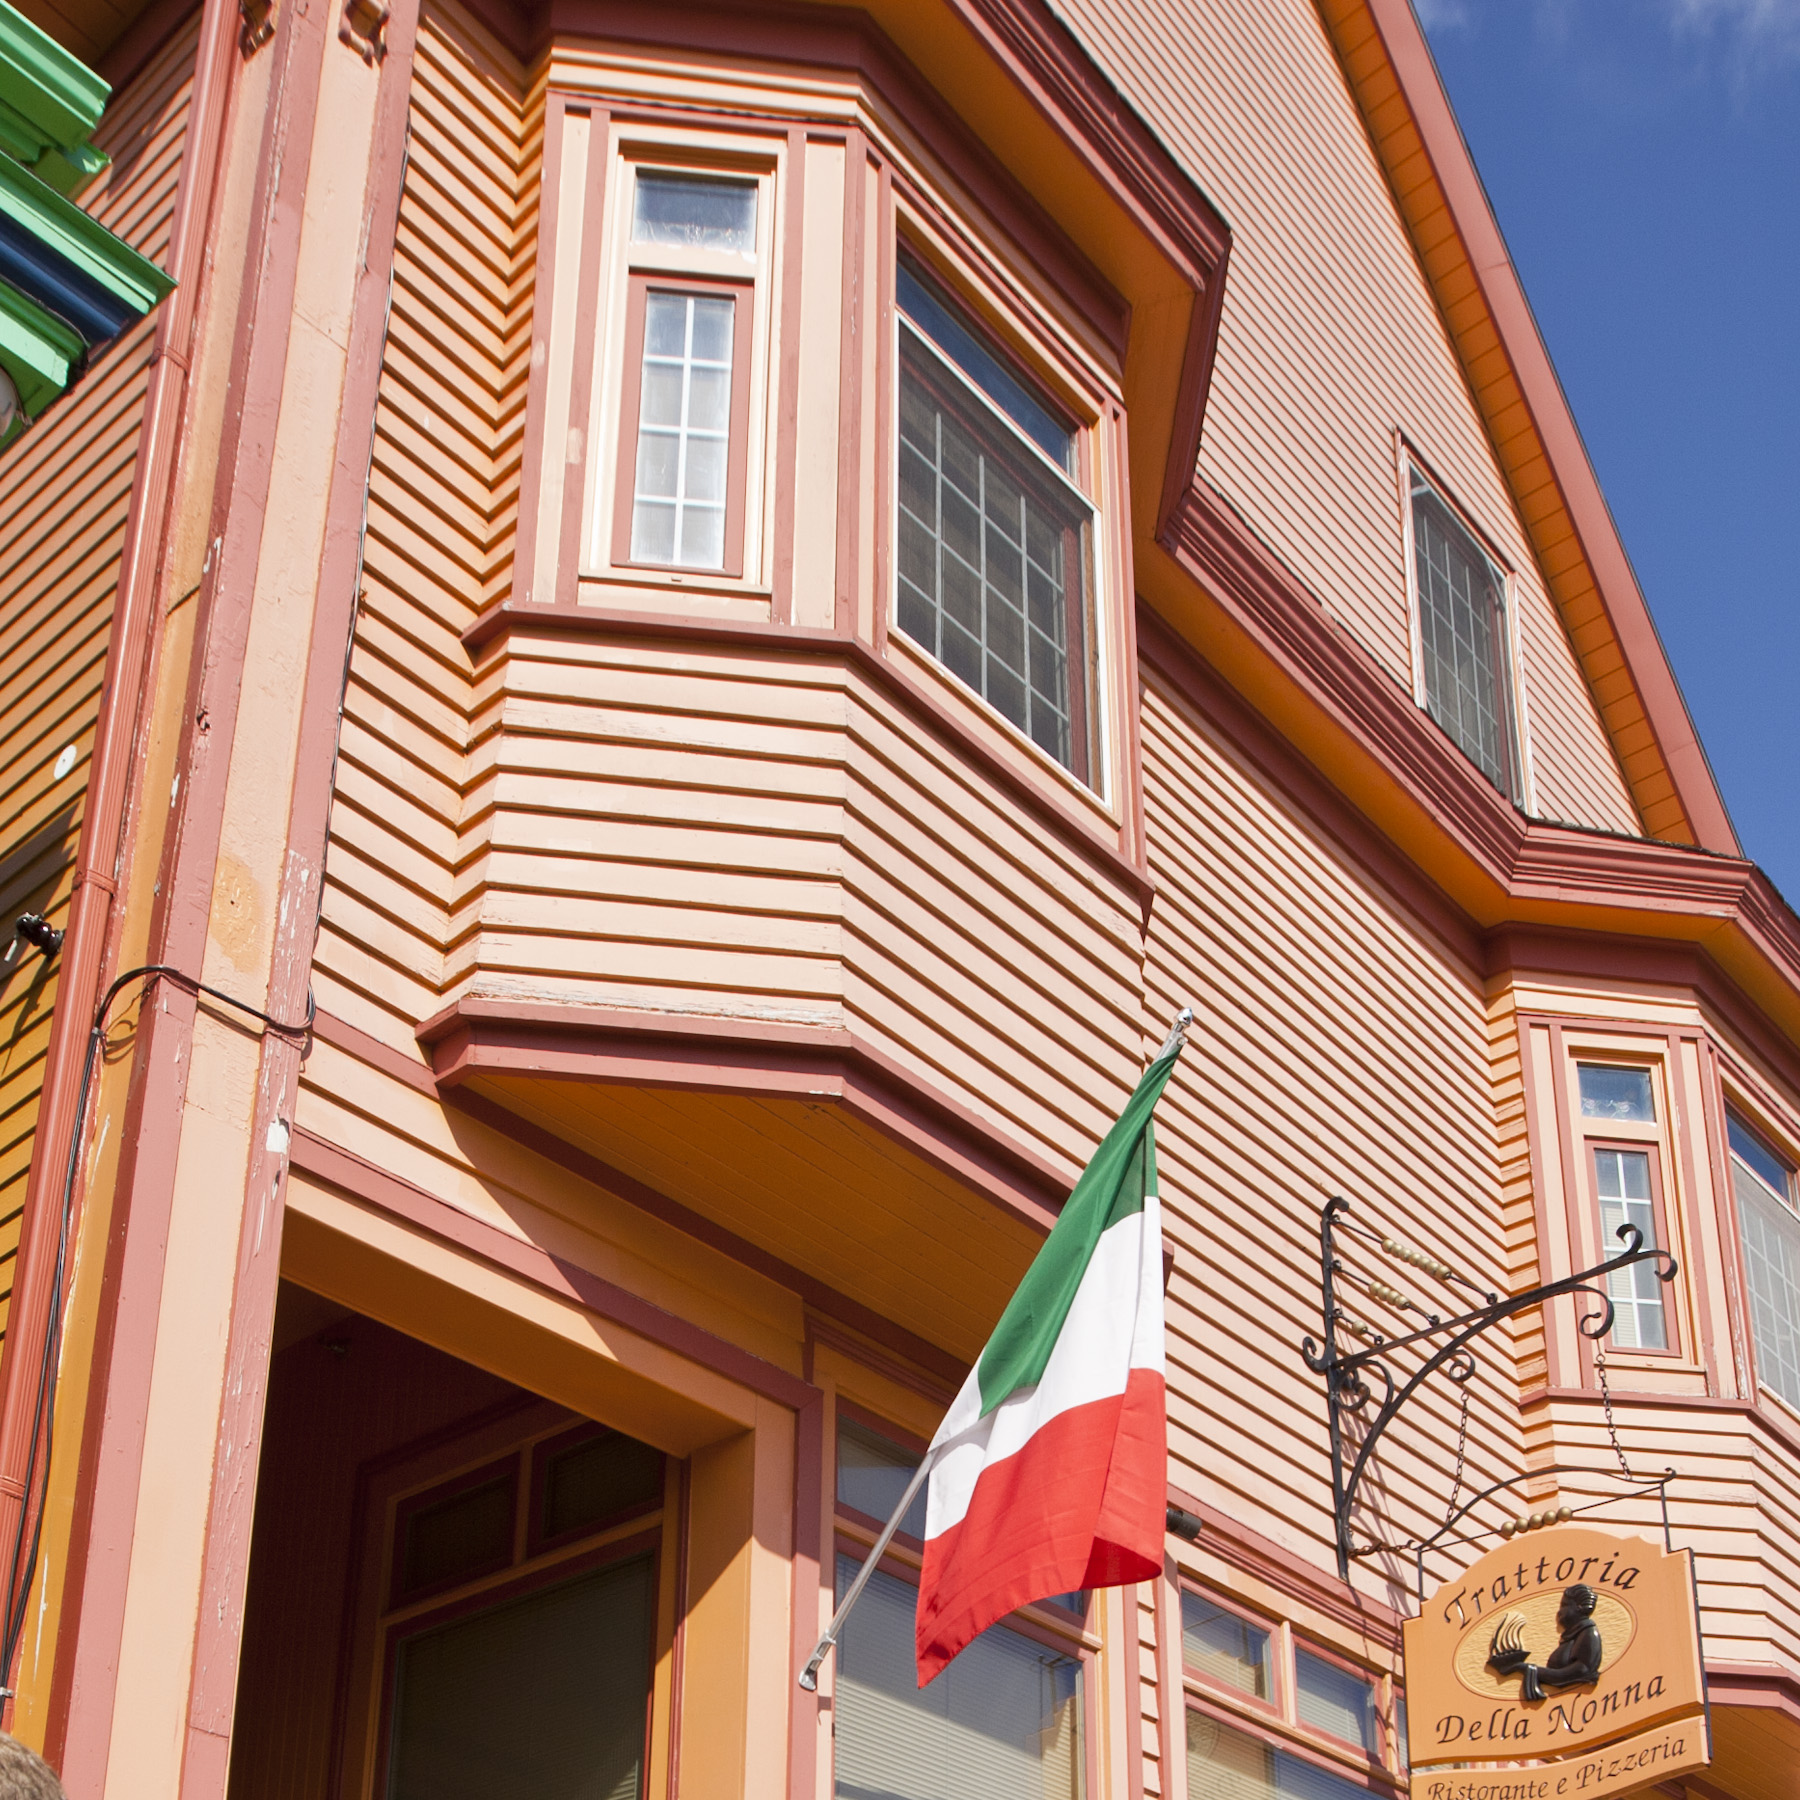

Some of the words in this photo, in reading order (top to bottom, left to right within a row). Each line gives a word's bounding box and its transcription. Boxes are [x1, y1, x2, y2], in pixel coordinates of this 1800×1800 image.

[1443, 1551, 1641, 1631] Trattoria
[1436, 1708, 1530, 1745] Della
[1548, 1674, 1667, 1735] Nonna
[1556, 1777, 1567, 1795] e
[1576, 1735, 1687, 1791] Pizzeria
